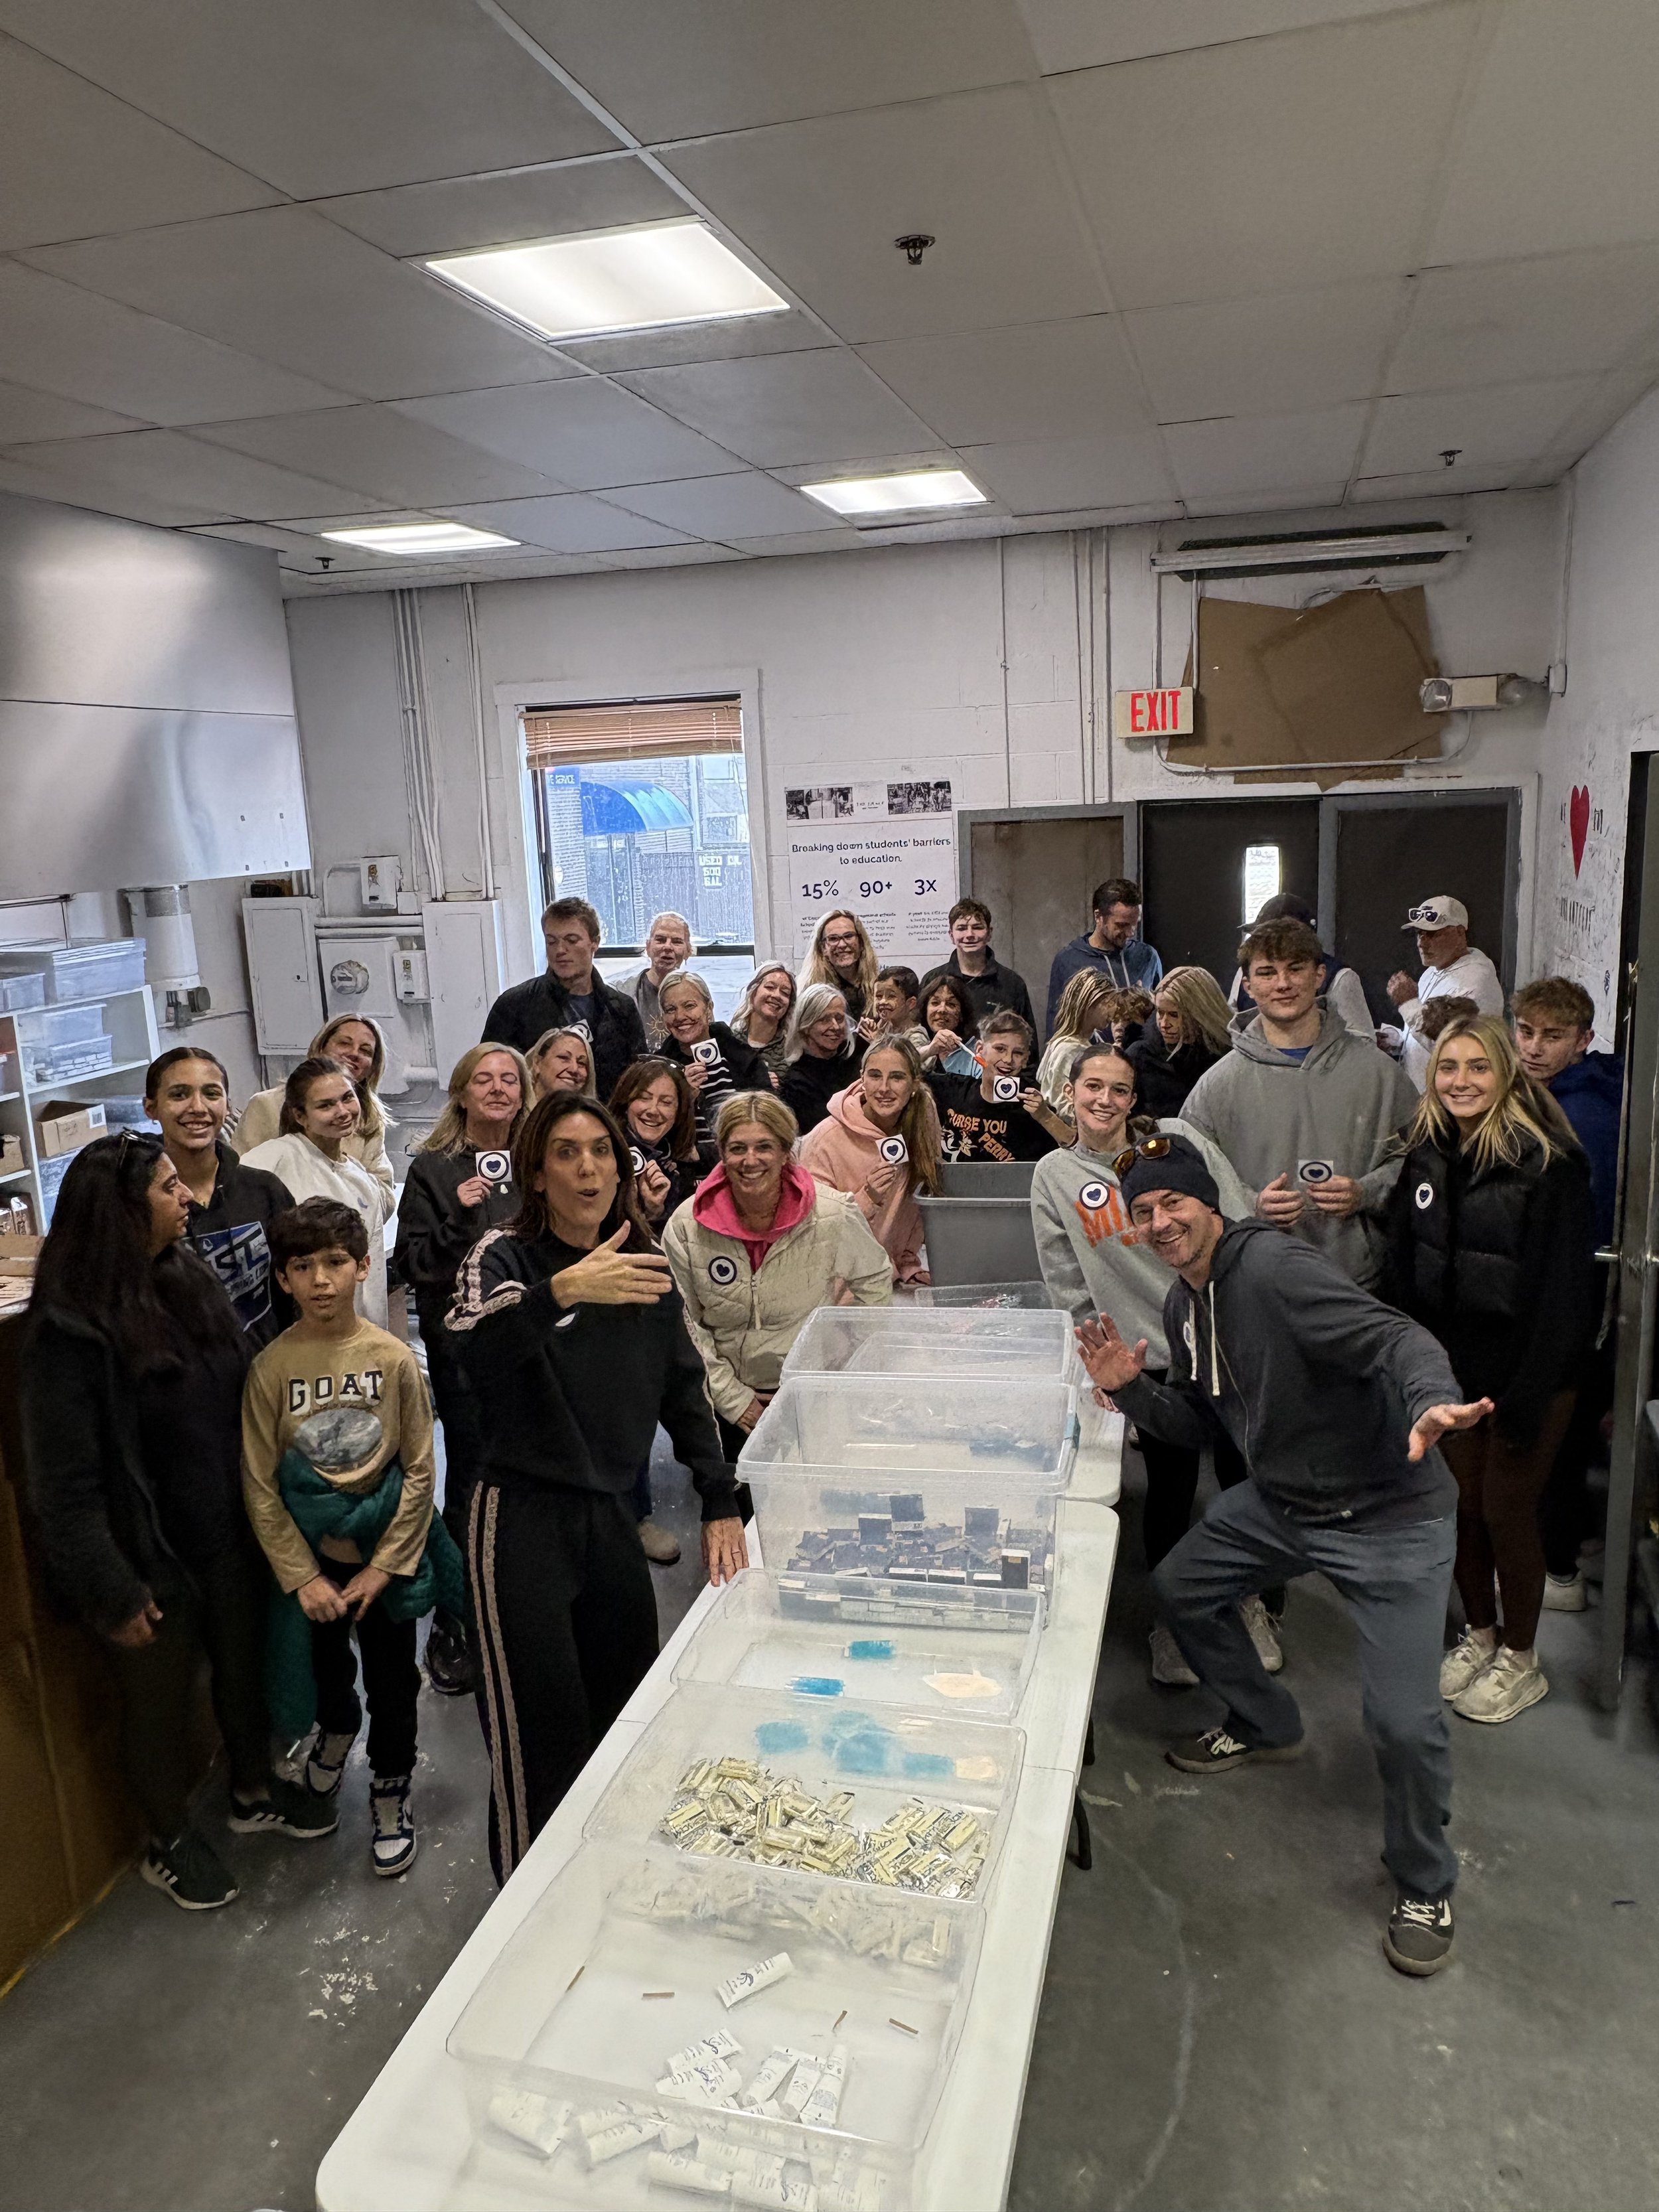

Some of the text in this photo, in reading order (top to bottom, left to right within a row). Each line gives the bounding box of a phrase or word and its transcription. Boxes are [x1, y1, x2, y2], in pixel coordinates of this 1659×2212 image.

[1131, 690, 1181, 733] EXIT
[792, 838, 951, 853] Breaking down students' barriers
[839, 856, 849, 865] to
[801, 879, 839, 900] 15%
[859, 880, 893, 898] 90+
[982, 1118, 1007, 1134] YOU
[978, 1132, 1016, 1162] PERRY
[288, 1370, 384, 1414] GOAT
